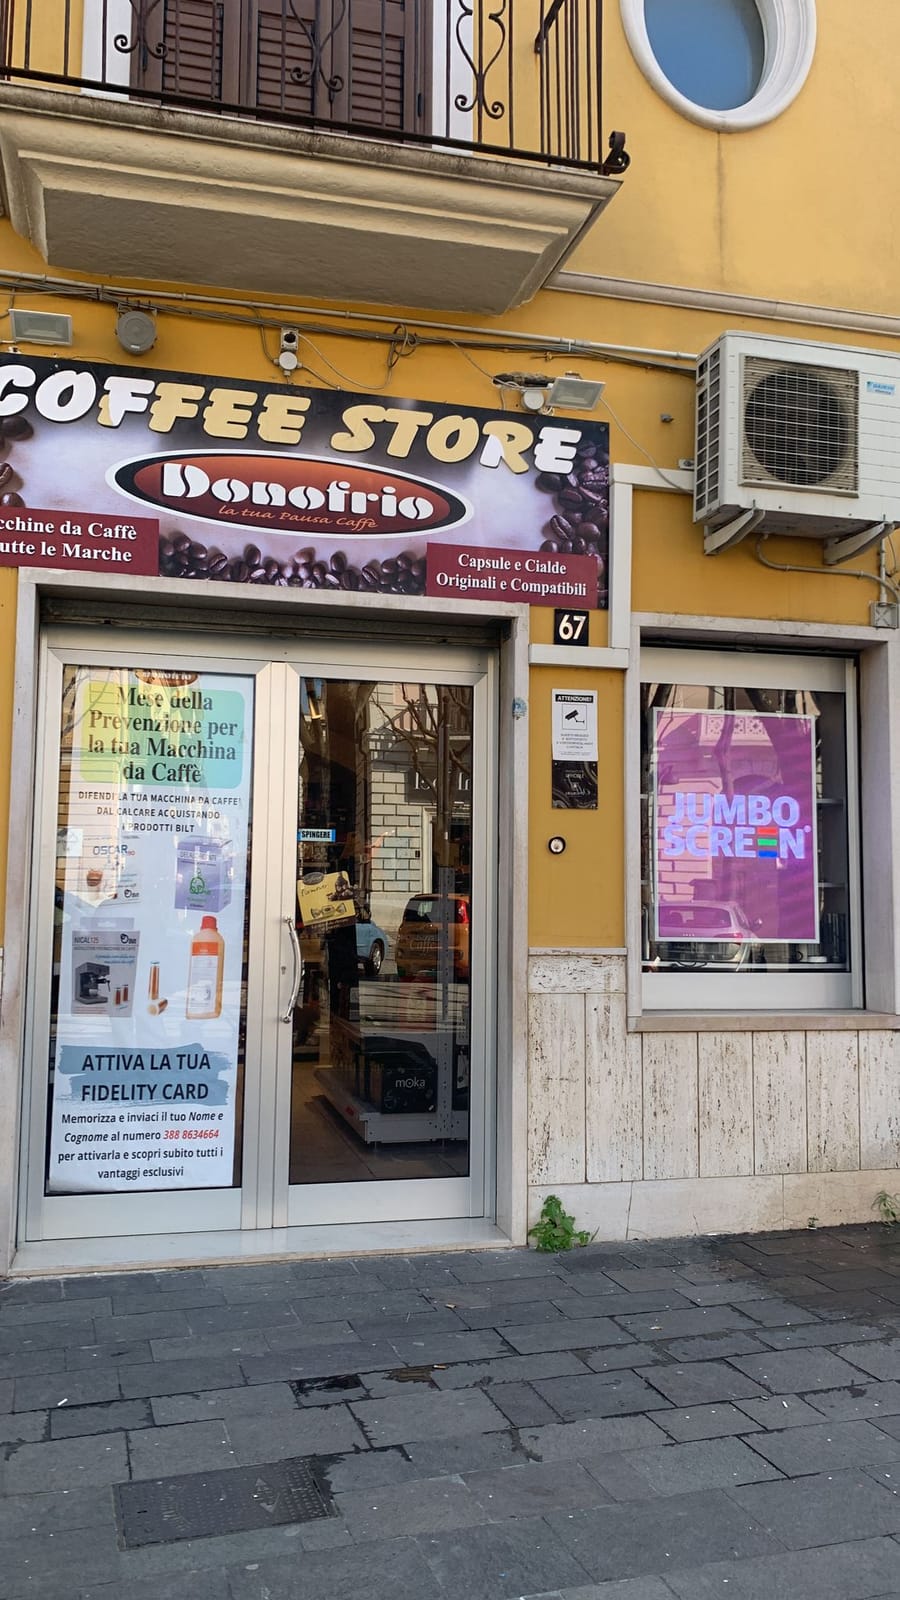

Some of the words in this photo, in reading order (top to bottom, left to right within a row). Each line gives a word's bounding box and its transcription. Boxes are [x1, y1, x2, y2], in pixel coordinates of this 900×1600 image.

[0, 364, 312, 445] COFFEE
[330, 404, 582, 474] STORE
[162, 462, 434, 521] Donofrio
[218, 505, 239, 516] la
[241, 508, 275, 519] tua
[279, 511, 334, 525] Pausa
[335, 516, 379, 532] Caffè
[60, 520, 82, 536] da
[87, 522, 138, 541] Caffè
[40, 541, 57, 557] le
[61, 542, 132, 562] Marche
[458, 553, 511, 573] Capsule
[514, 560, 522, 570] e
[524, 559, 567, 575] Cialde
[436, 571, 497, 590] Originali
[500, 579, 508, 591] e
[510, 579, 587, 597] Compatibili
[558, 614, 587, 641] 67
[116, 687, 164, 707] Mese
[170, 690, 213, 710] della
[90, 710, 201, 733] Prevenzione
[207, 720, 238, 740] per
[88, 735, 104, 753] la
[111, 737, 140, 755] tua
[147, 737, 236, 760] Macchina
[123, 762, 145, 780] da
[151, 762, 201, 783] Caffè
[78, 791, 115, 801] DIFENDI
[131, 793, 148, 802] TUA
[150, 795, 196, 804] MACCHINA
[97, 806, 113, 815] DAL
[117, 807, 155, 817] CALCARE
[157, 810, 220, 819] ACQUISTANDO
[668, 791, 800, 827] JUMBO
[128, 823, 173, 833] PRODOTTI
[175, 825, 195, 833] BILT
[301, 830, 331, 839] SPINGERE
[82, 1054, 145, 1071] ATTIVA
[150, 1054, 171, 1070] LA
[176, 1053, 211, 1070] TUA
[82, 1084, 157, 1101] FIDELITY
[162, 1083, 209, 1100] CARD
[395, 1077, 426, 1089] moka
[61, 1113, 116, 1124] Memorizza
[118, 1115, 125, 1123] e
[127, 1112, 159, 1122] inviaci
[161, 1111, 167, 1121] il
[170, 1112, 187, 1121] tuo
[188, 1111, 215, 1121] Nome
[217, 1112, 224, 1121] e
[64, 1131, 108, 1145] Cognome
[110, 1131, 120, 1141] al
[122, 1131, 161, 1141] numero
[163, 1129, 180, 1140] 388
[182, 1129, 219, 1139] 8634664
[58, 1153, 75, 1163] per
[77, 1150, 121, 1161] attivarla
[123, 1152, 129, 1160] e
[131, 1149, 161, 1162] scopri
[163, 1147, 194, 1158] subito
[196, 1147, 218, 1157] tutti
[220, 1147, 223, 1157] i
[97, 1168, 140, 1180] vantaggi
[142, 1166, 184, 1177] esclusivi
